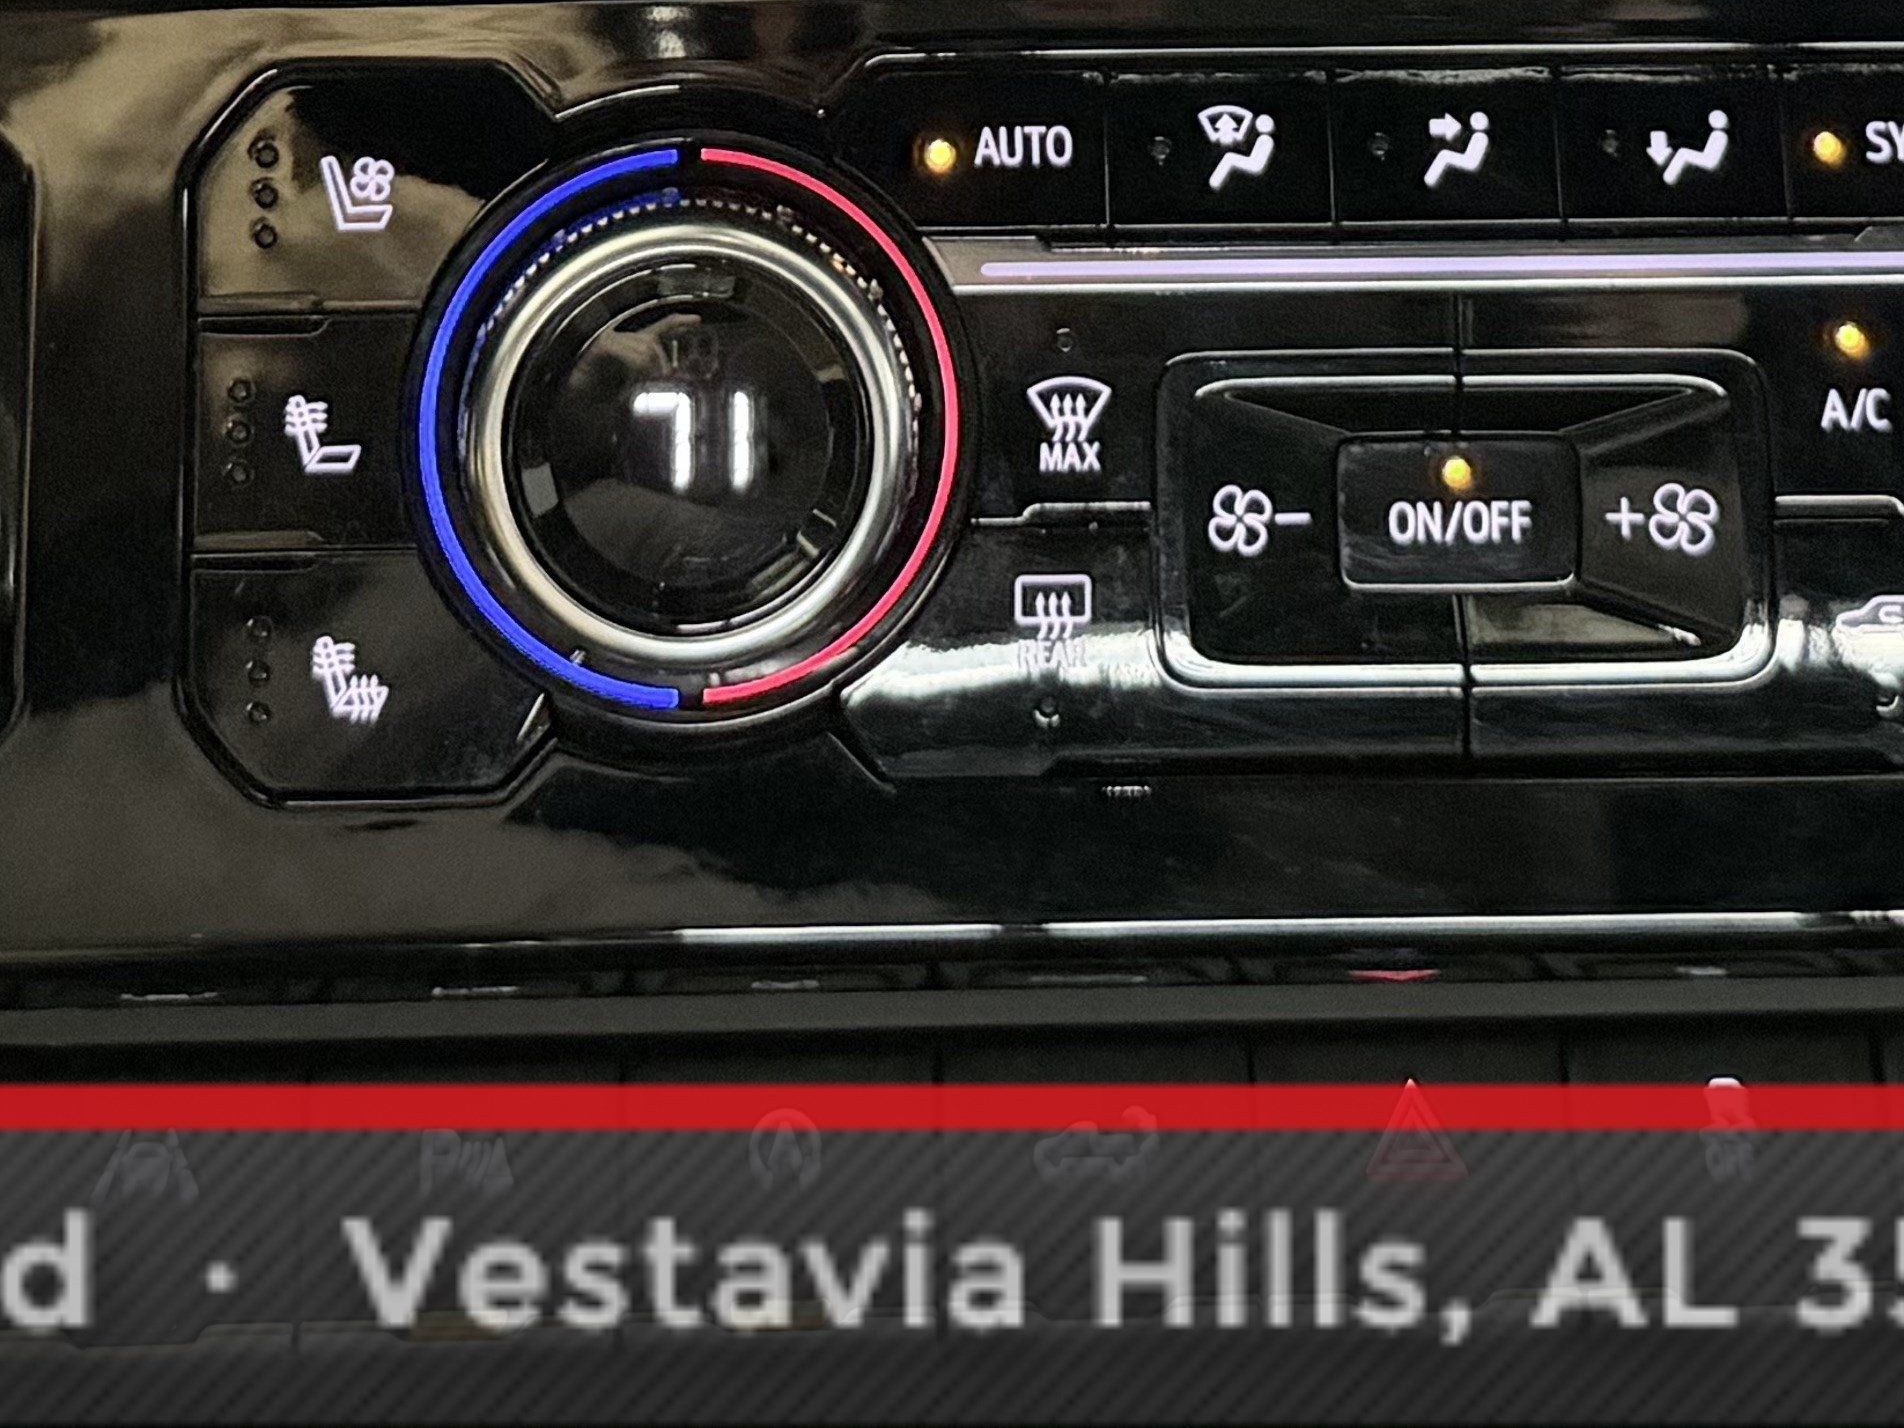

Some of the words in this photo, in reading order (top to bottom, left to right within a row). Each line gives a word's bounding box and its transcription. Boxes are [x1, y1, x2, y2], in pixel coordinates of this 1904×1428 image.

[973, 124, 1075, 168] AUTO
[1819, 387, 1893, 432] A/C
[632, 390, 753, 493] 71
[1038, 442, 1102, 474] MAX
[1387, 498, 1534, 545] ON/OFF
[1017, 638, 1087, 670] REAR
